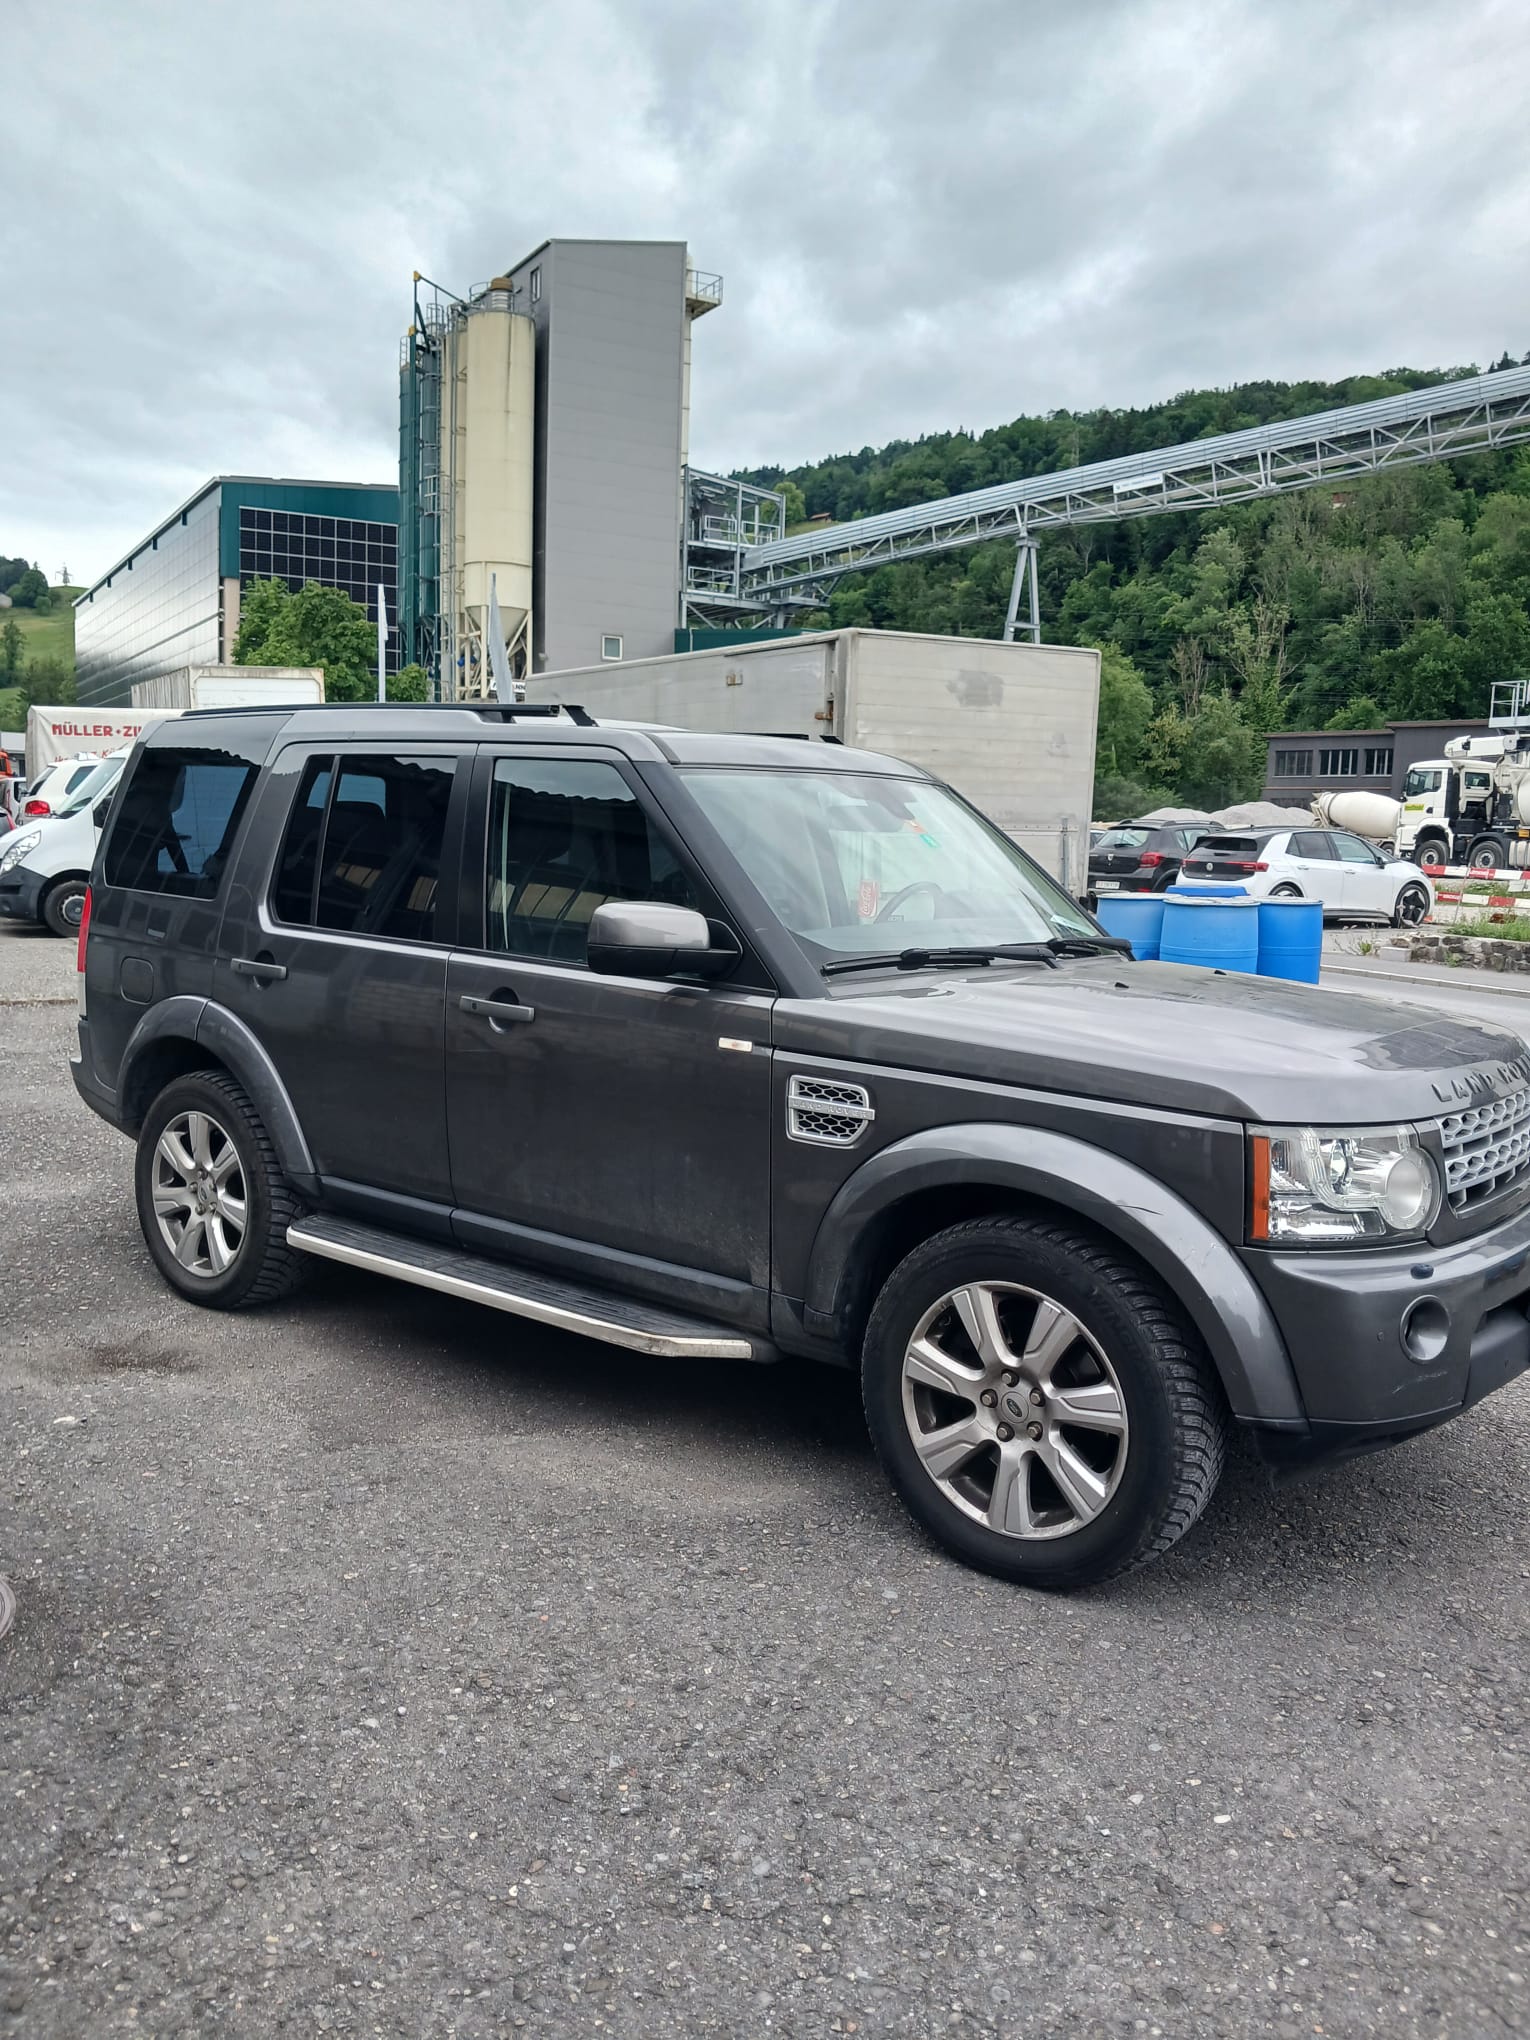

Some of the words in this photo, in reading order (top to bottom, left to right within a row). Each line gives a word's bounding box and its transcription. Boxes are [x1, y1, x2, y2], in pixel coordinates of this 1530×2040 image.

[52, 721, 113, 737] MÜLLER
[123, 726, 142, 737] ZI
[1431, 1071, 1496, 1102] LAND
[792, 1101, 821, 1110] LAND
[828, 1106, 868, 1118] ROVER
